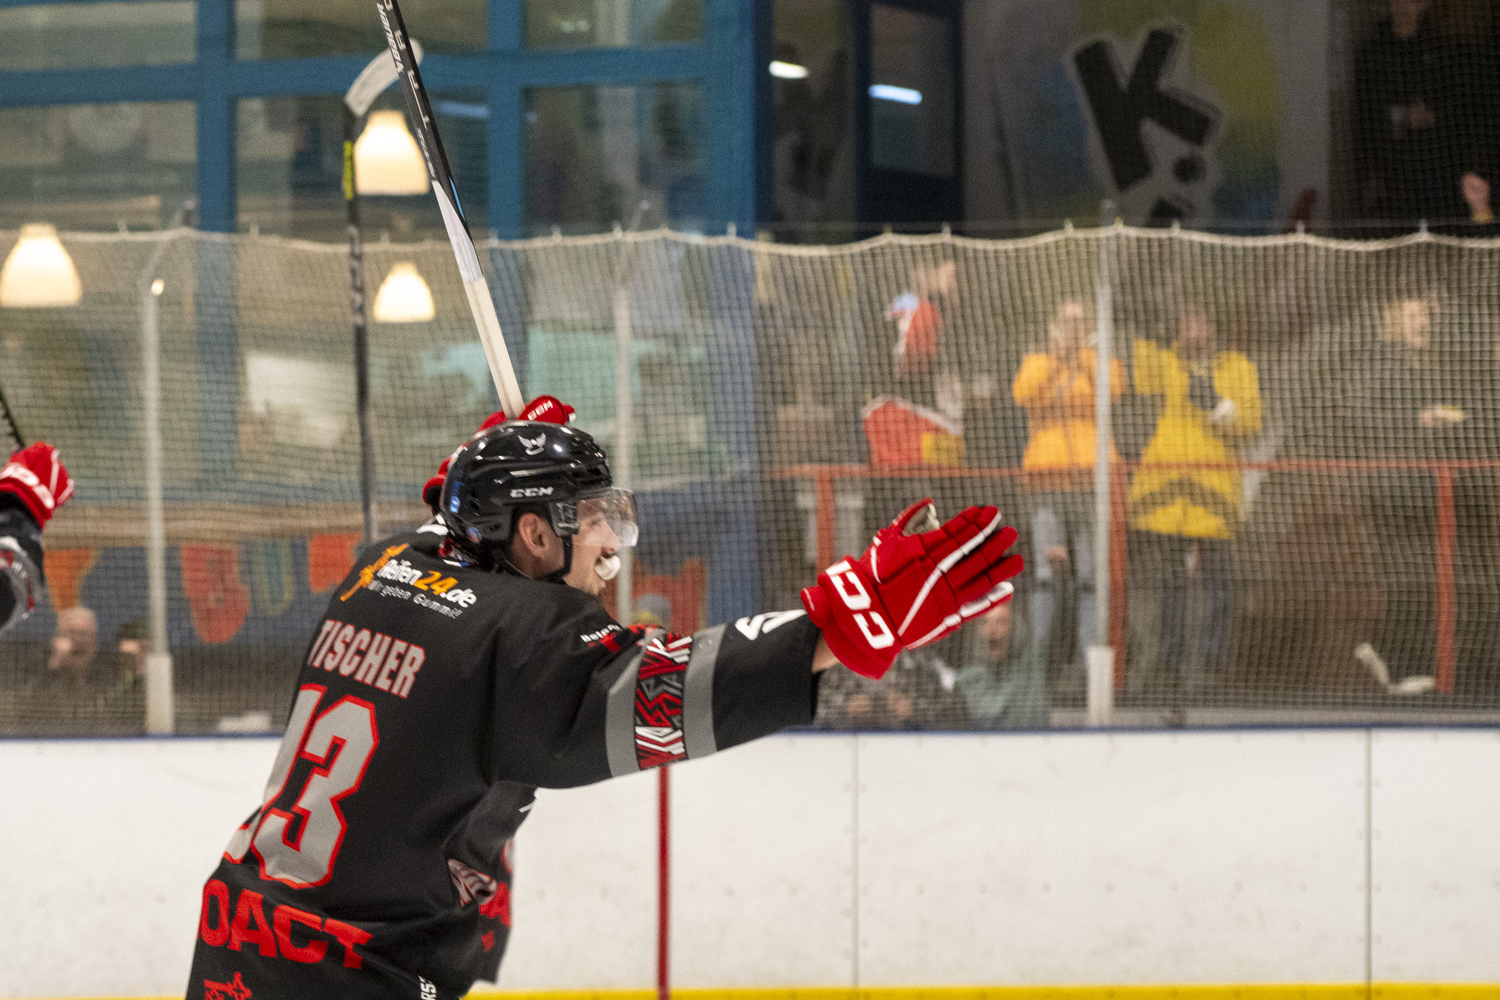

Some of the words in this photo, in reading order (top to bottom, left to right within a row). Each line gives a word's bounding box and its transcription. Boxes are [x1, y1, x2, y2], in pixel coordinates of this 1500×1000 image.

[509, 486, 555, 499] CCM
[825, 559, 896, 650] CC
[307, 619, 426, 699] TISCHER
